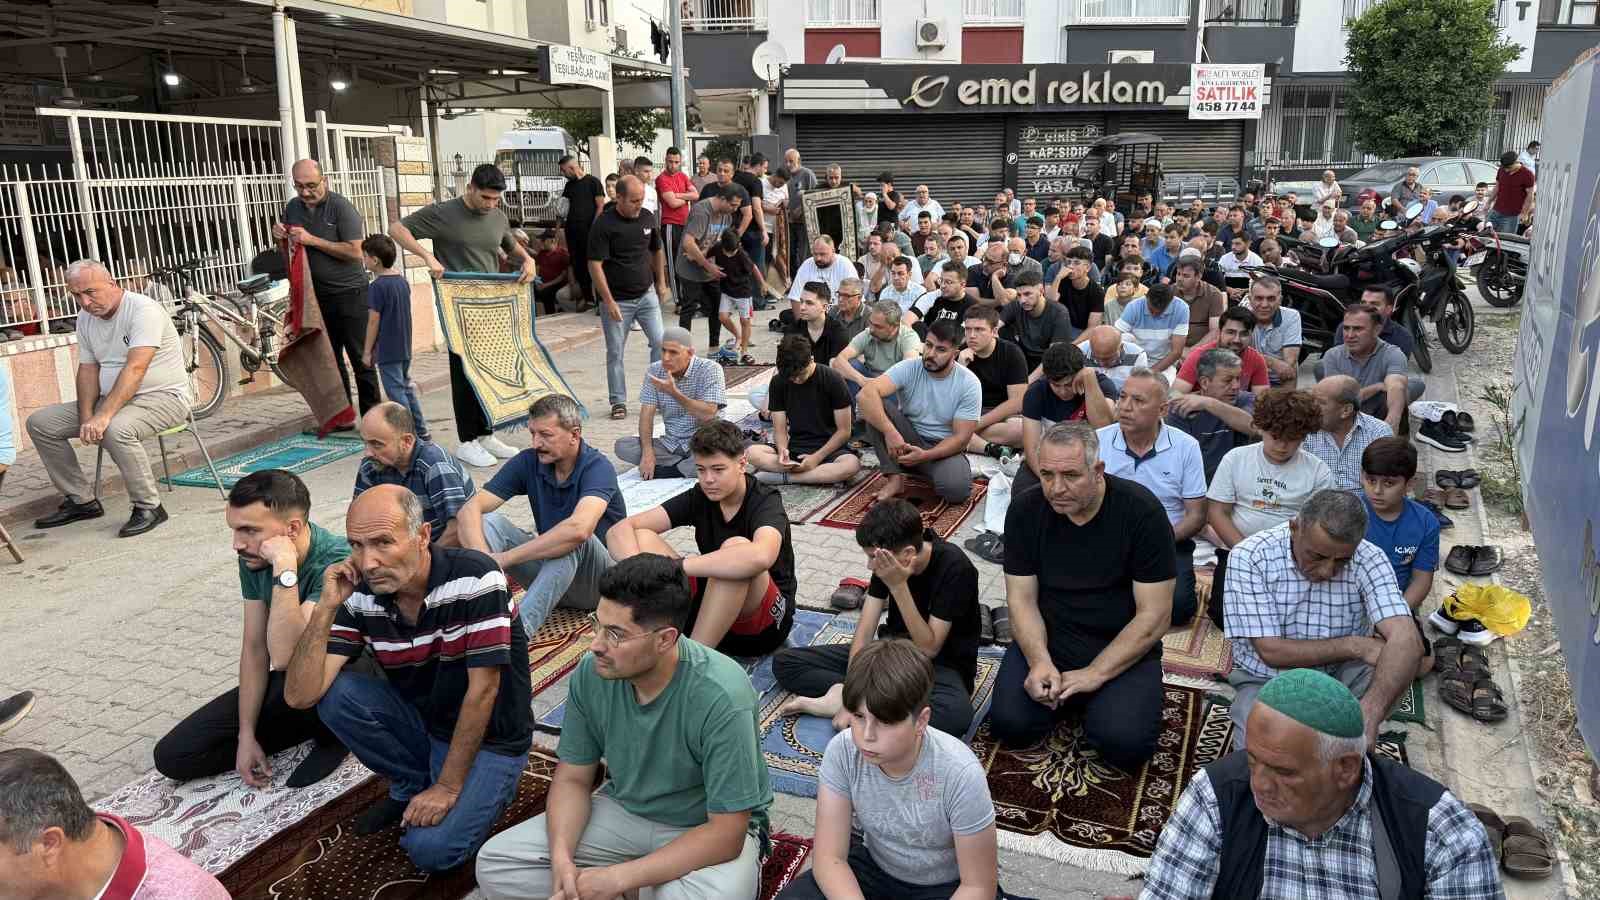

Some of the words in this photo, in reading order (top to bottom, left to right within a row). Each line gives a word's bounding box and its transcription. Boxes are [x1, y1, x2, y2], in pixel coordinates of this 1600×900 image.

[957, 68, 1036, 105] emd
[1047, 69, 1165, 104] reklam
[1196, 86, 1257, 101] SATILIK
[1196, 102, 1222, 112] 458
[1225, 102, 1238, 112] 77
[1240, 102, 1257, 112] 44
